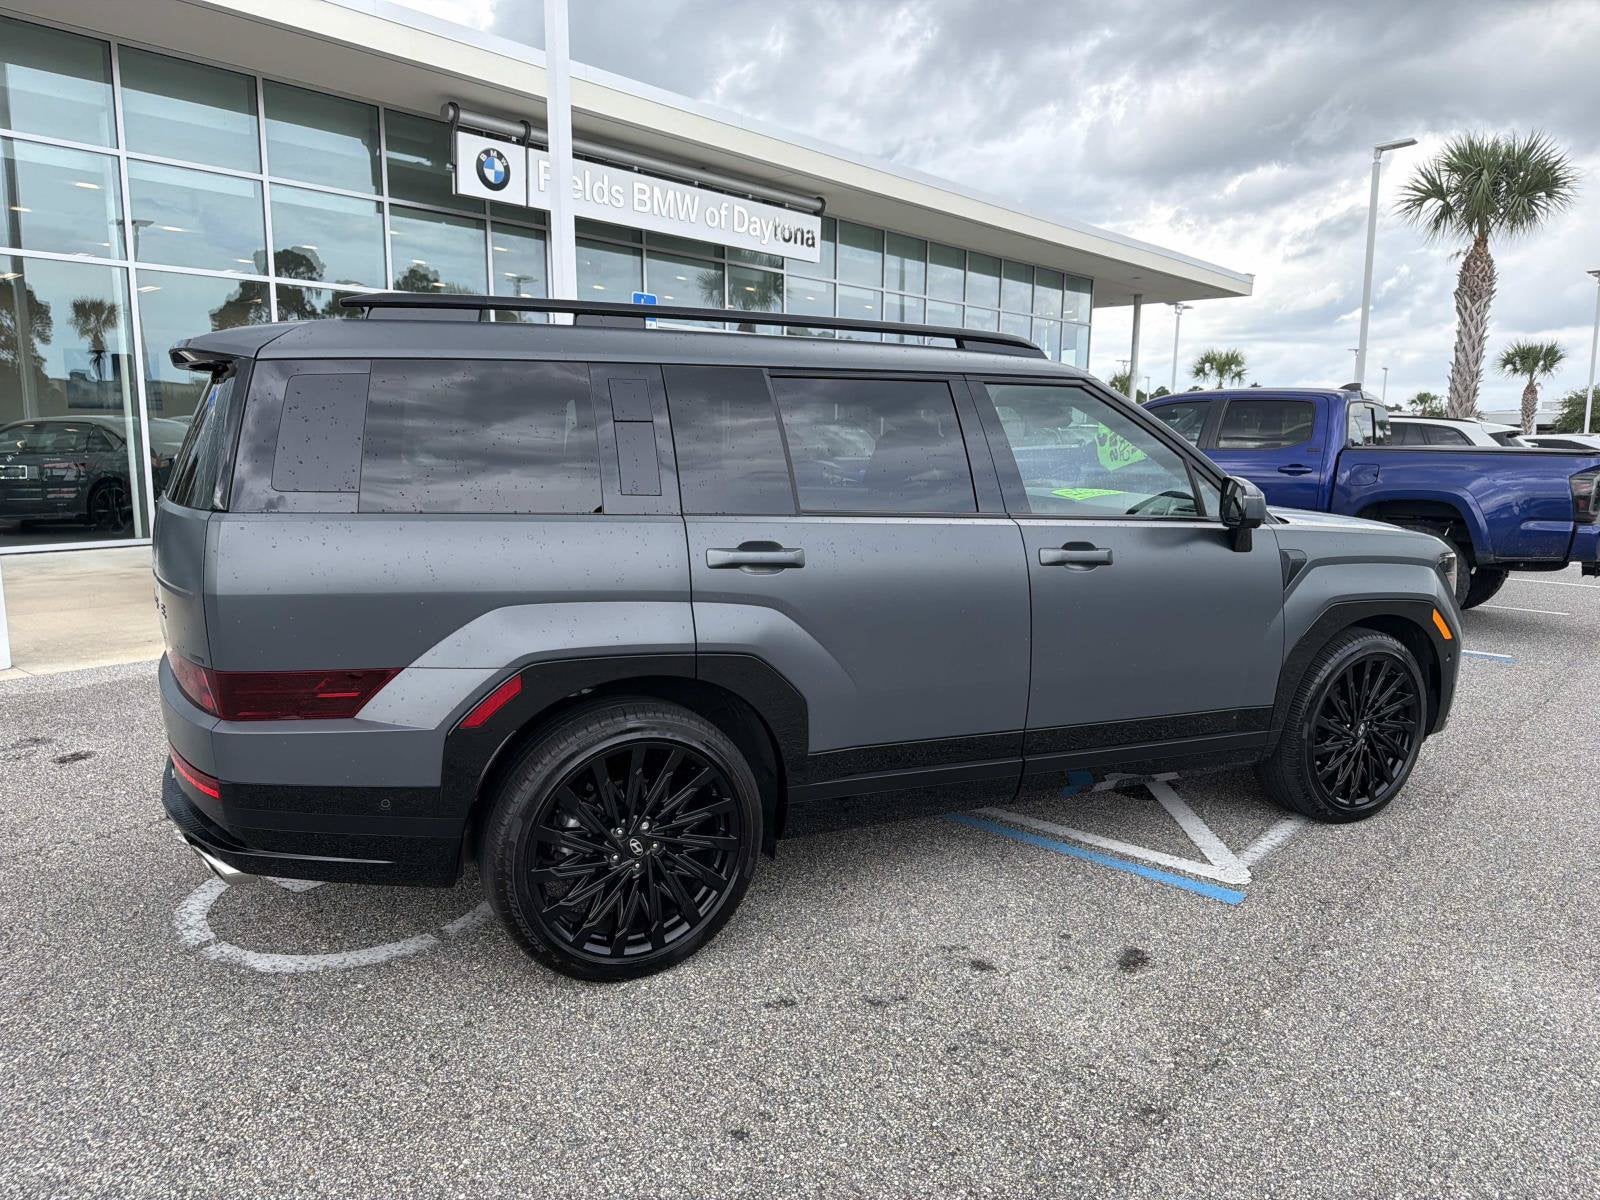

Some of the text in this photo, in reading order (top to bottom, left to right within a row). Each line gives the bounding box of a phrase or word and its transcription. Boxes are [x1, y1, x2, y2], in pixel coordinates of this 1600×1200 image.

[480, 150, 507, 166] BMW
[538, 159, 816, 248] Felds BMW of Daytona
